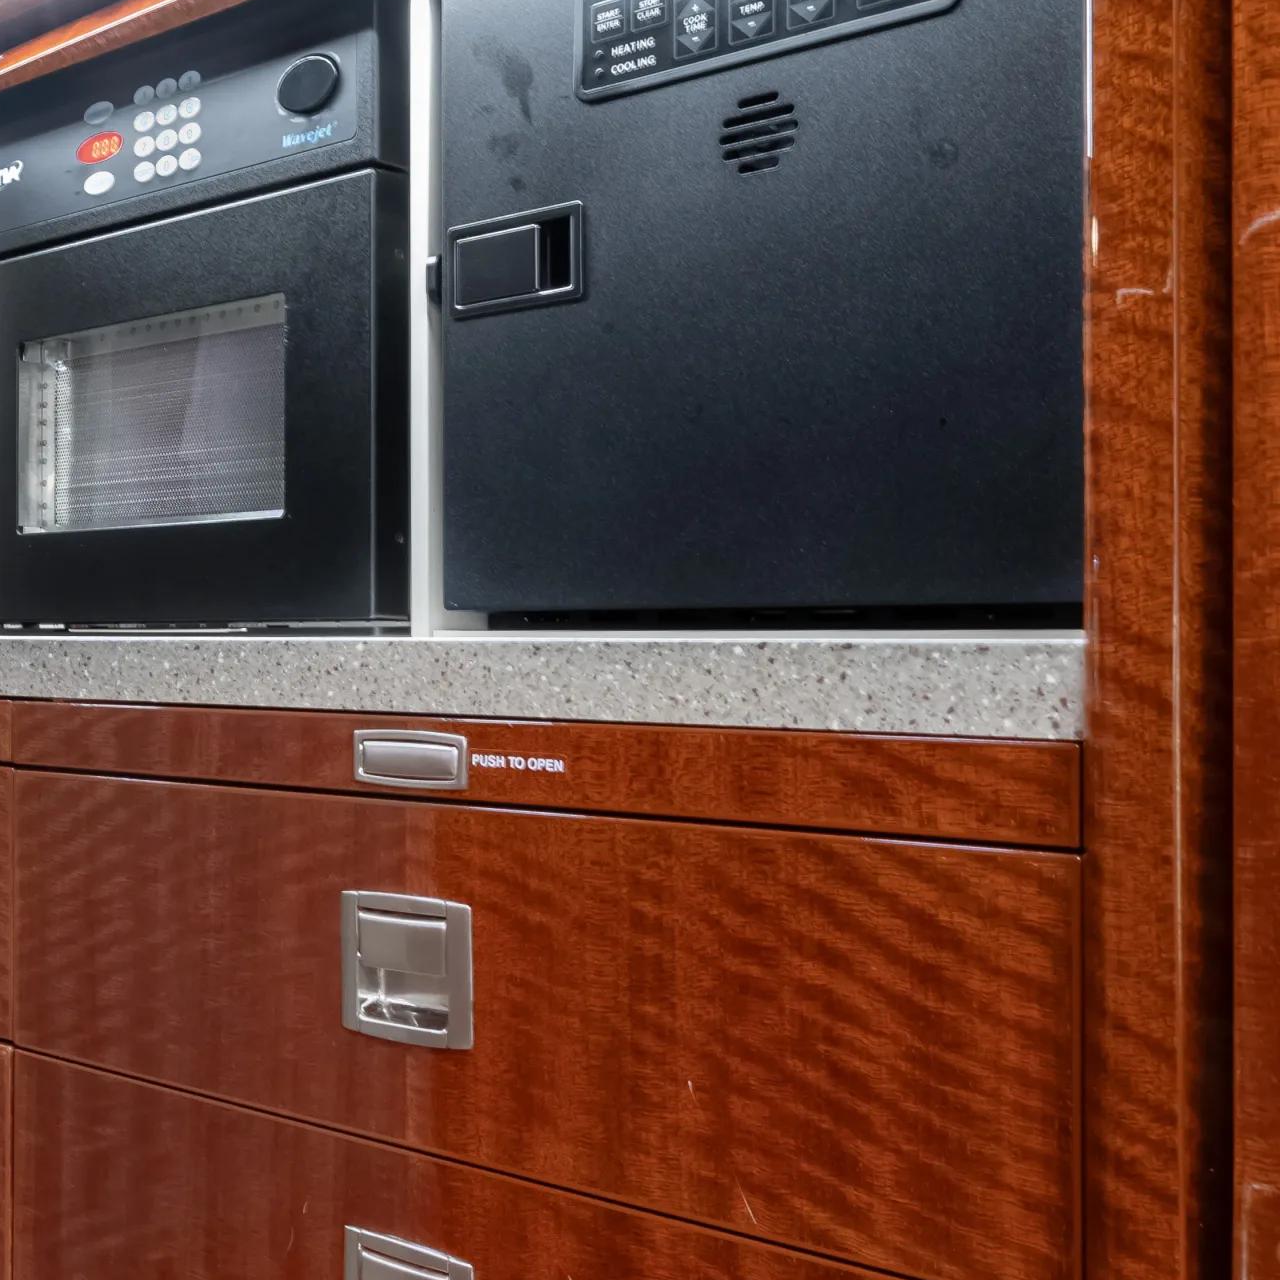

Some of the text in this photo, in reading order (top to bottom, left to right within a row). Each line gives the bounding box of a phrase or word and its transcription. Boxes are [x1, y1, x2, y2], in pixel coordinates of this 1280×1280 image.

[596, 7, 621, 21] START
[636, 7, 662, 21] CLEAR
[739, 1, 766, 16] TEMP
[596, 19, 621, 33] ENTER
[683, 12, 708, 26] COOK
[684, 21, 707, 34] TIME
[611, 36, 656, 58] HEATING
[610, 54, 657, 76] COOLING
[471, 753, 564, 772] PUSH TO OPEN
